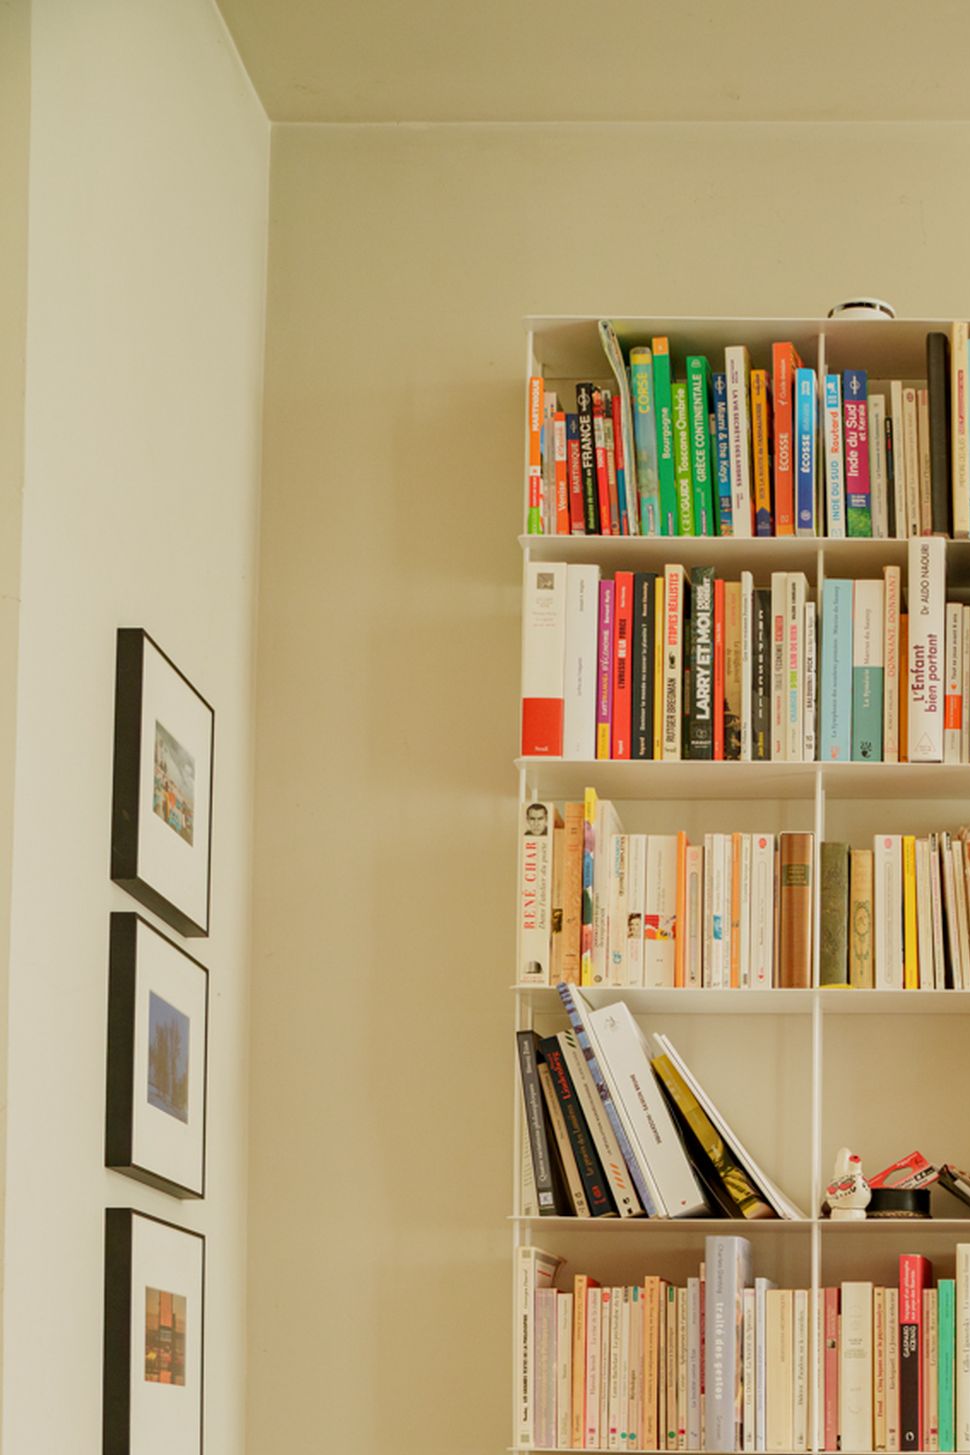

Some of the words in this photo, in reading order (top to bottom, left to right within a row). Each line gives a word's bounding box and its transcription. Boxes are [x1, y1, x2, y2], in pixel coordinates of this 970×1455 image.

[637, 373, 650, 414] CORSE
[676, 388, 686, 429] Ombrie
[692, 374, 705, 447] CONTINENTALE
[717, 402, 725, 431] Miami
[846, 404, 858, 428] Sud
[858, 405, 866, 431] Kerala
[662, 407, 671, 459] Bourgogne
[719, 432, 726, 440] &
[830, 411, 839, 453] Routard
[847, 431, 858, 448] du
[859, 432, 866, 441] et
[679, 431, 688, 473] Toscane
[694, 449, 706, 482] GRÈCE
[719, 443, 727, 458] the
[778, 433, 789, 471] ÉCOSSE
[801, 435, 810, 473] ÉCOSSE
[848, 450, 859, 477] Inde
[569, 442, 580, 493] MARTINIQUE
[719, 460, 728, 483] Keys
[831, 461, 839, 480] SUD
[558, 481, 566, 511] Venise
[831, 482, 840, 496] DU
[832, 498, 840, 521] INDE
[921, 544, 930, 578] NAOURI
[668, 573, 679, 612] RÉALISTES
[888, 575, 896, 623] DONNANT
[921, 581, 929, 603] ALDO
[920, 605, 929, 615] Dr
[668, 615, 678, 645] UTOPIES
[696, 611, 710, 643] MOI
[696, 647, 710, 665] ET
[887, 626, 896, 677] DONNANT,
[927, 633, 940, 681] portant
[911, 644, 925, 702] L'Enfant
[666, 678, 676, 713] BREGMAN
[695, 668, 710, 720] LARRY
[925, 684, 937, 712] bien
[665, 715, 675, 742] RUTGER
[524, 841, 537, 882] CHAR
[540, 866, 547, 878] du
[539, 879, 547, 908] l'atelier
[522, 890, 536, 929] RENÉ
[715, 1302, 724, 1335] traité
[715, 1339, 724, 1359] des
[909, 1326, 917, 1351] KŒNIG
[713, 1363, 723, 1400] gestes
